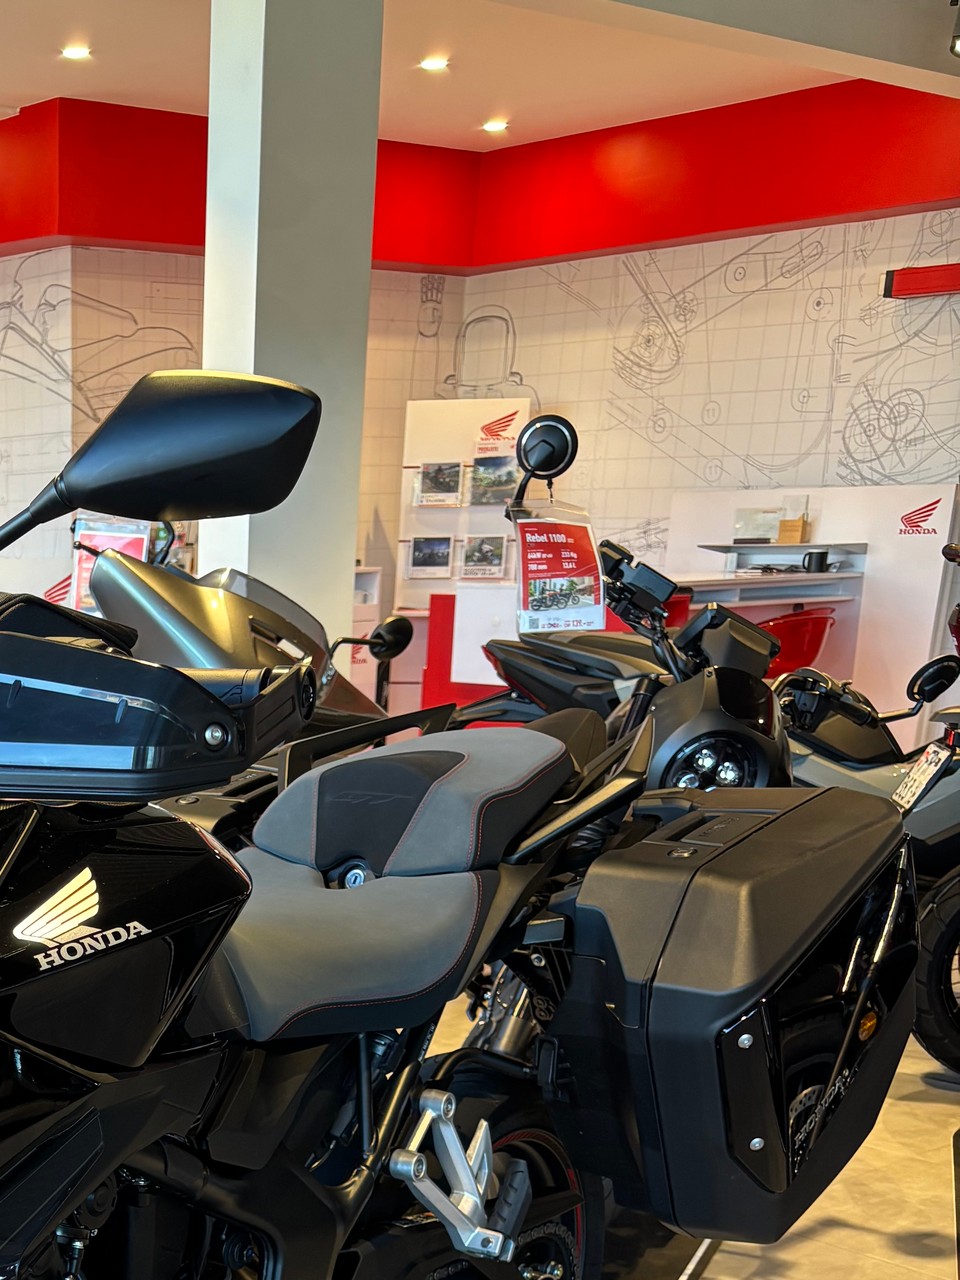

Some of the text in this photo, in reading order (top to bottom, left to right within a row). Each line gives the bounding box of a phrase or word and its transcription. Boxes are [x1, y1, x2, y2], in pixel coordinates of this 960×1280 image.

[525, 533, 548, 543] Rebel
[549, 533, 567, 543] 1100
[33, 921, 152, 971] HONDA
[793, 1075, 845, 1149] HONDA
